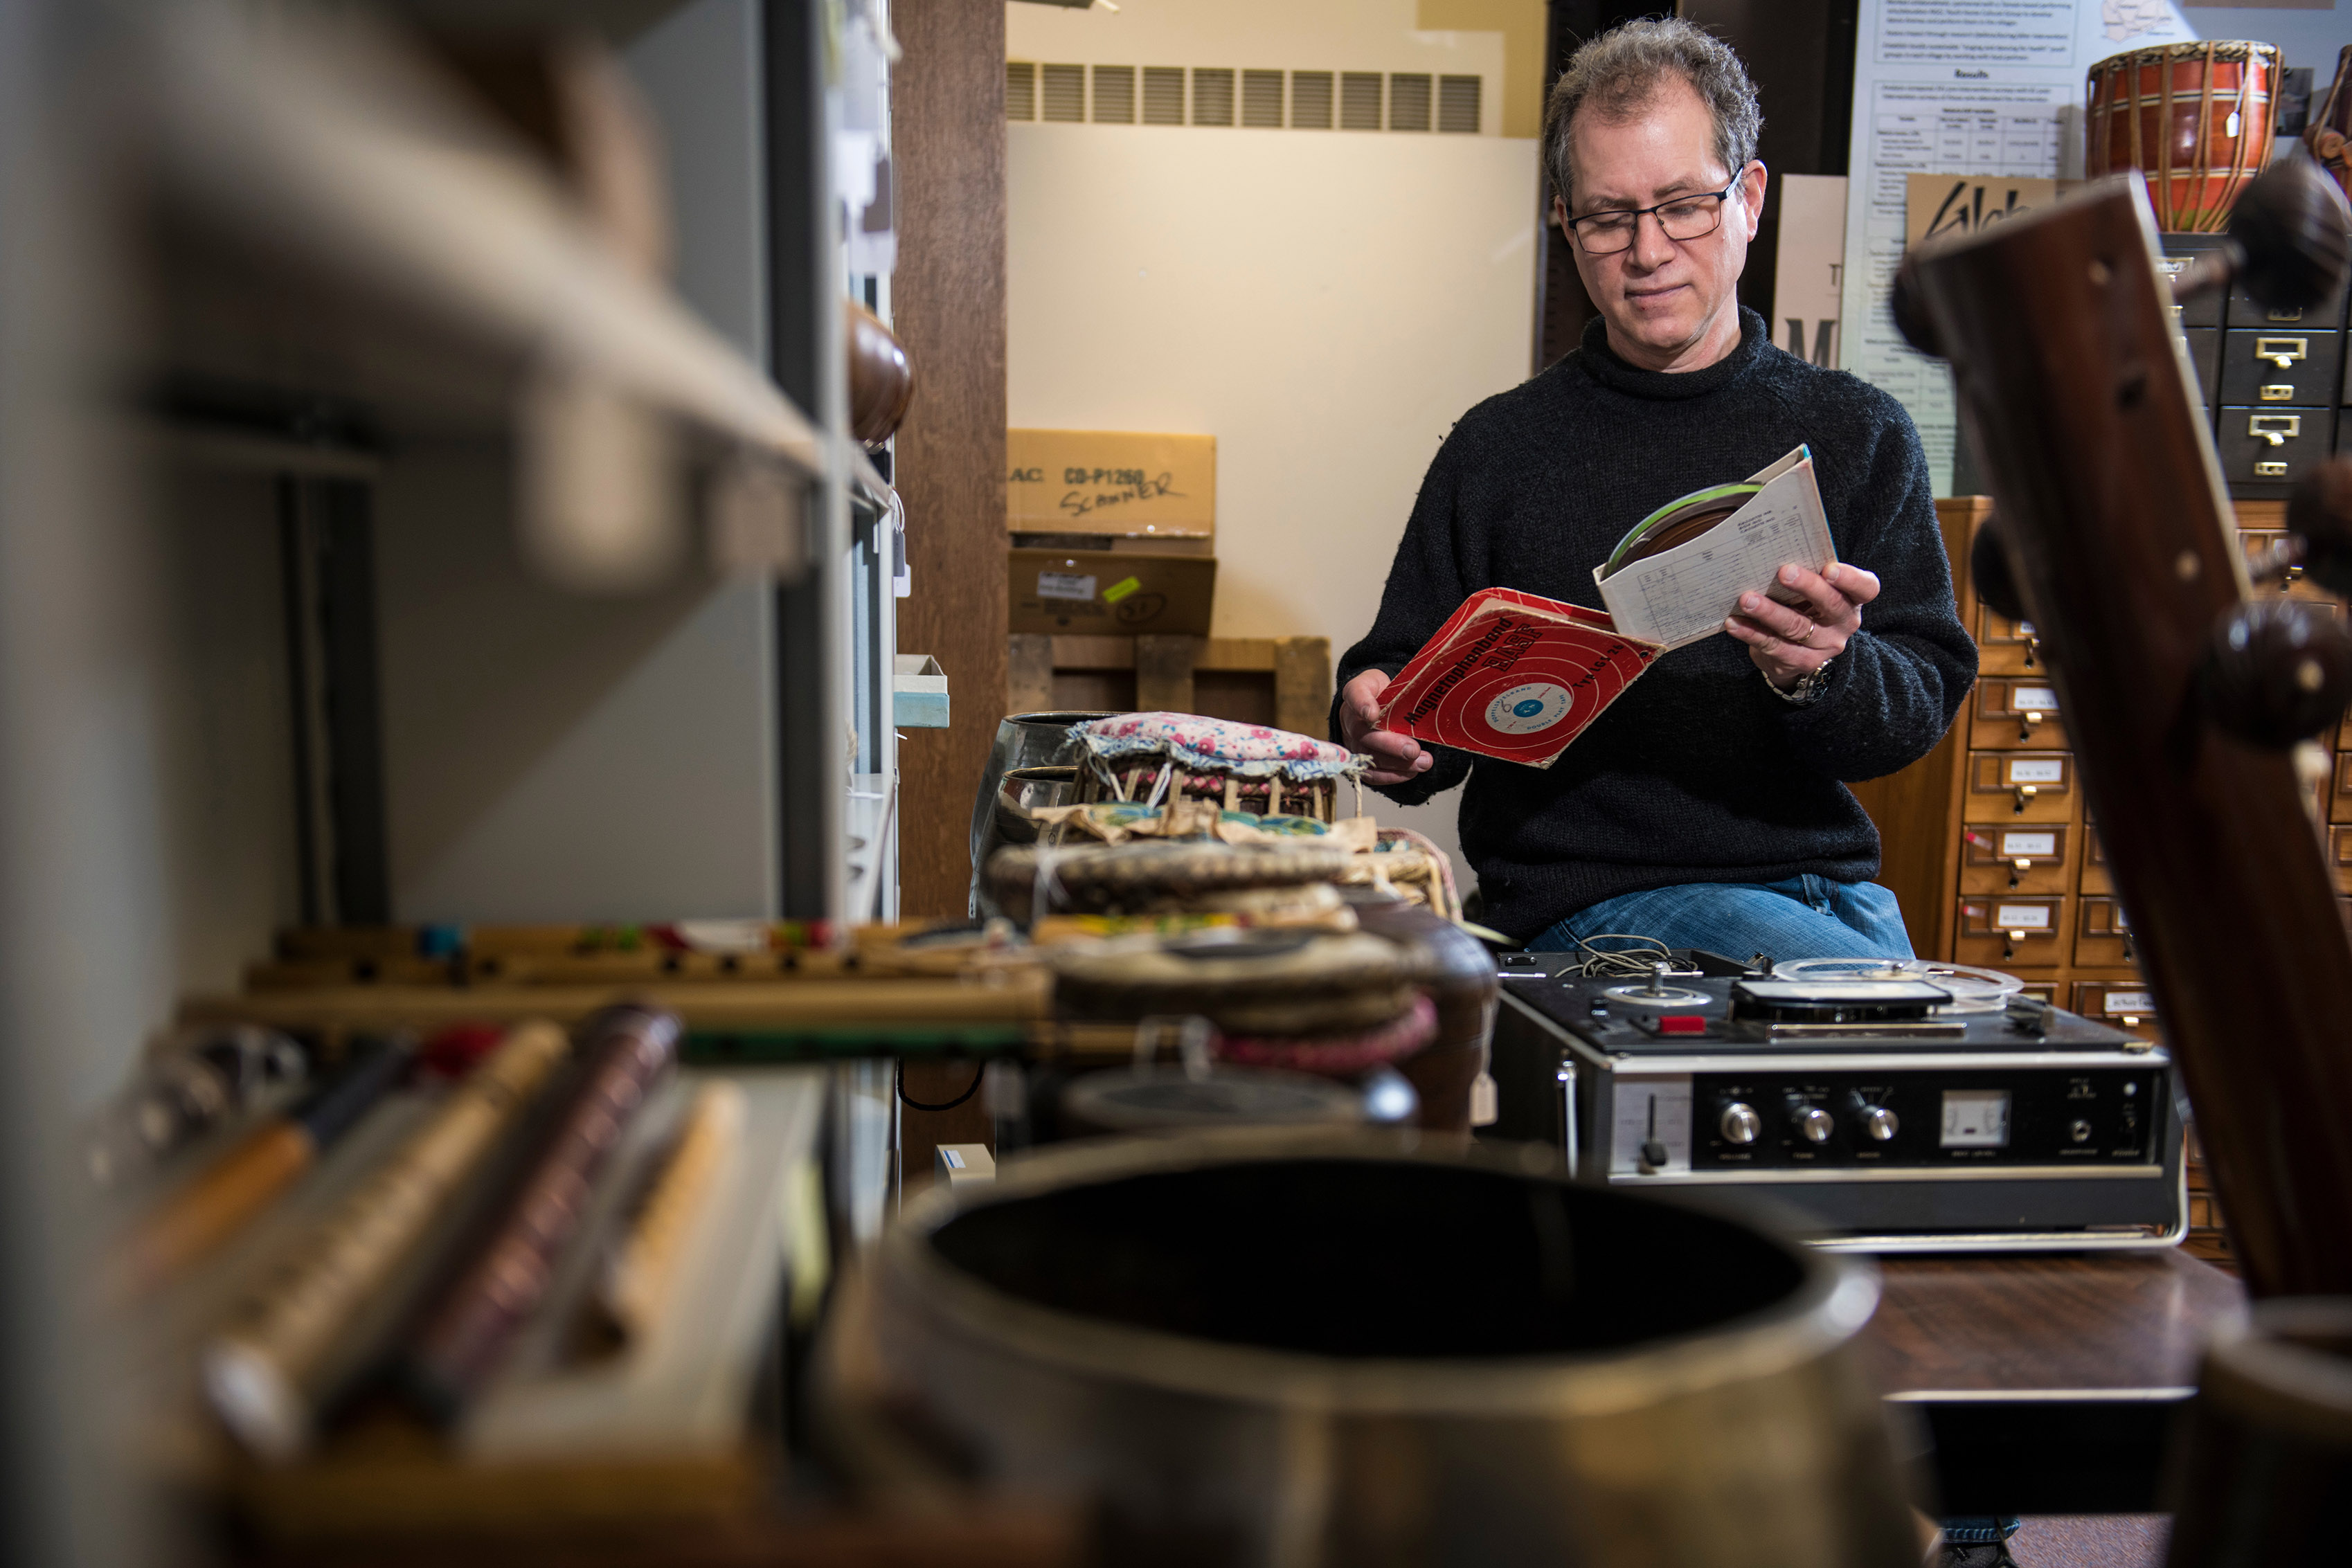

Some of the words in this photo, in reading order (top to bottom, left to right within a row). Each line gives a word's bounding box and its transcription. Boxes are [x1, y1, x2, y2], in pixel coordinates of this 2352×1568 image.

[1481, 622, 1543, 672] BASF
[1607, 645, 1624, 656] 26
[1403, 616, 1514, 726] Magnetophonband
[1527, 719, 1552, 730] DOUBLE
